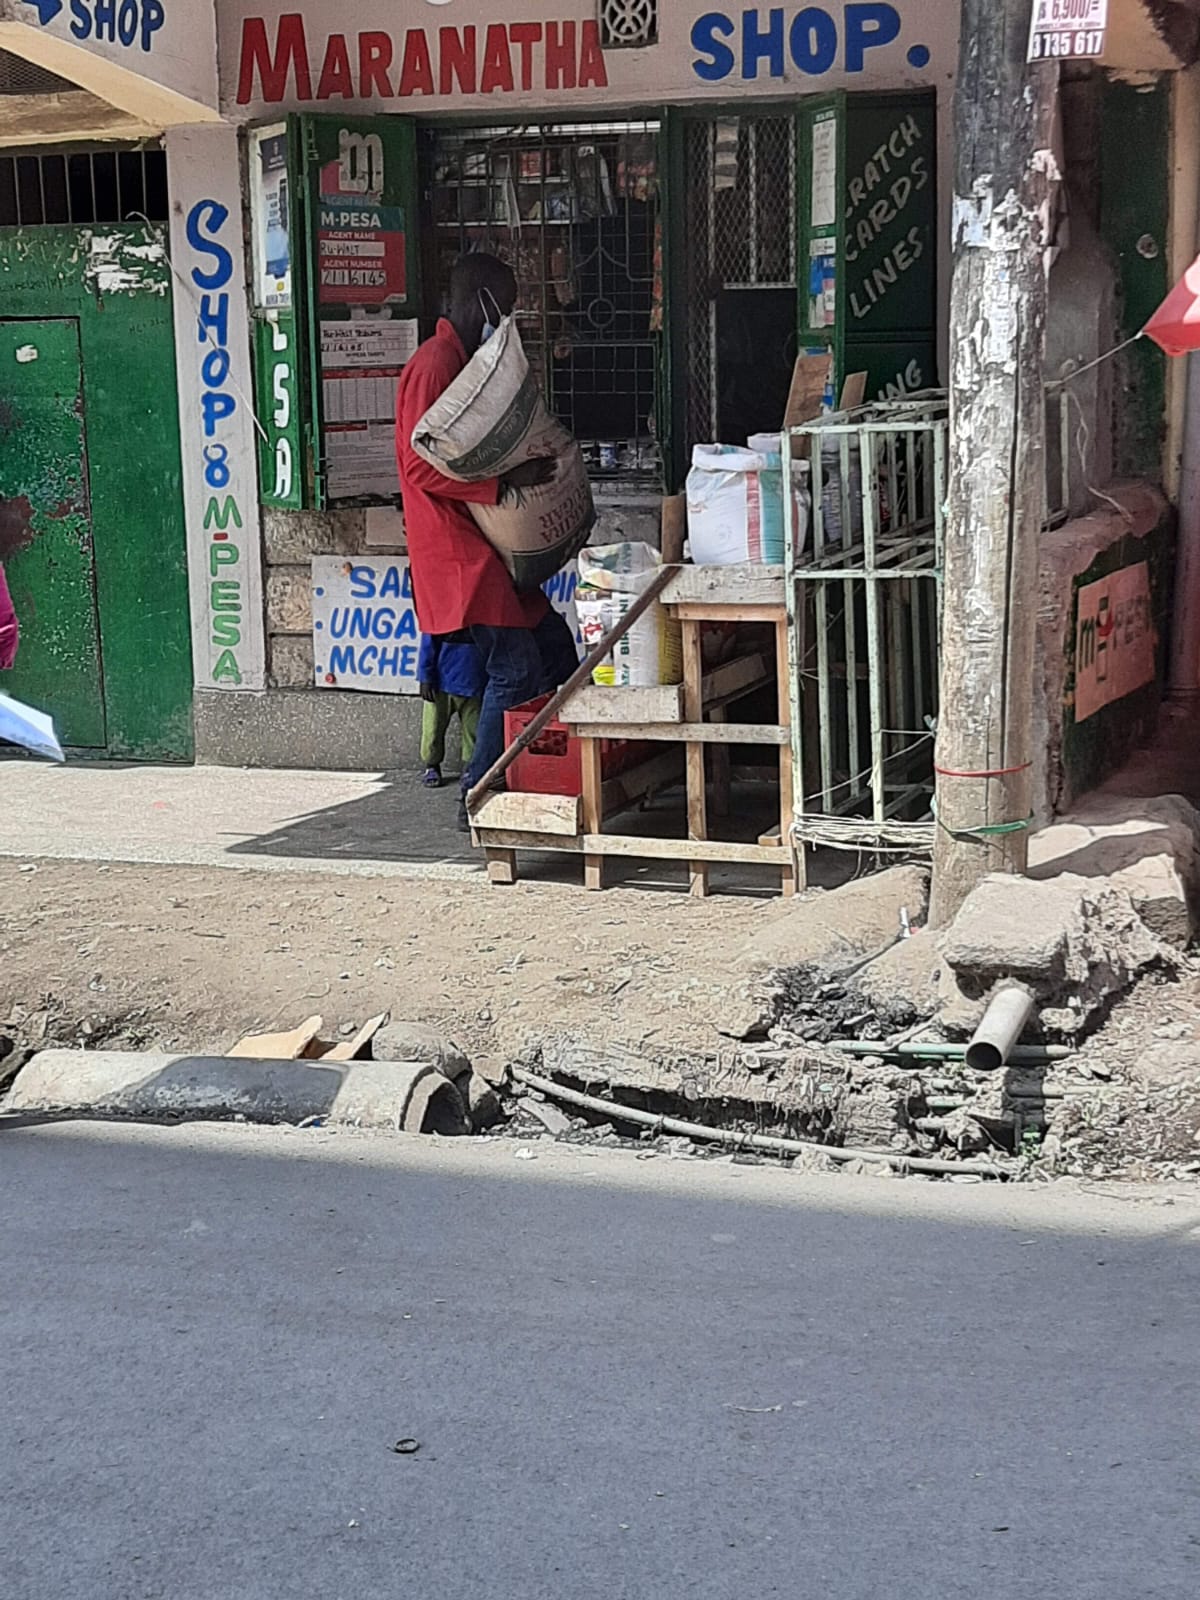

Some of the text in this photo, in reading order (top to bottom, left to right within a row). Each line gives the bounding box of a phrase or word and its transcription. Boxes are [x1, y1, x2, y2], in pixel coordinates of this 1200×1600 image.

[70, 0, 164, 51] SHOP
[236, 13, 608, 105] MARANATHA
[354, 232, 376, 240] NAME
[844, 156, 928, 262] CARDS
[324, 260, 383, 268] AGENT NUMBER
[850, 226, 923, 318] LINES
[187, 199, 236, 437] SHOP
[203, 494, 243, 685] M-PESA
[330, 608, 416, 639] UNGA
[329, 646, 417, 676] MCHE
